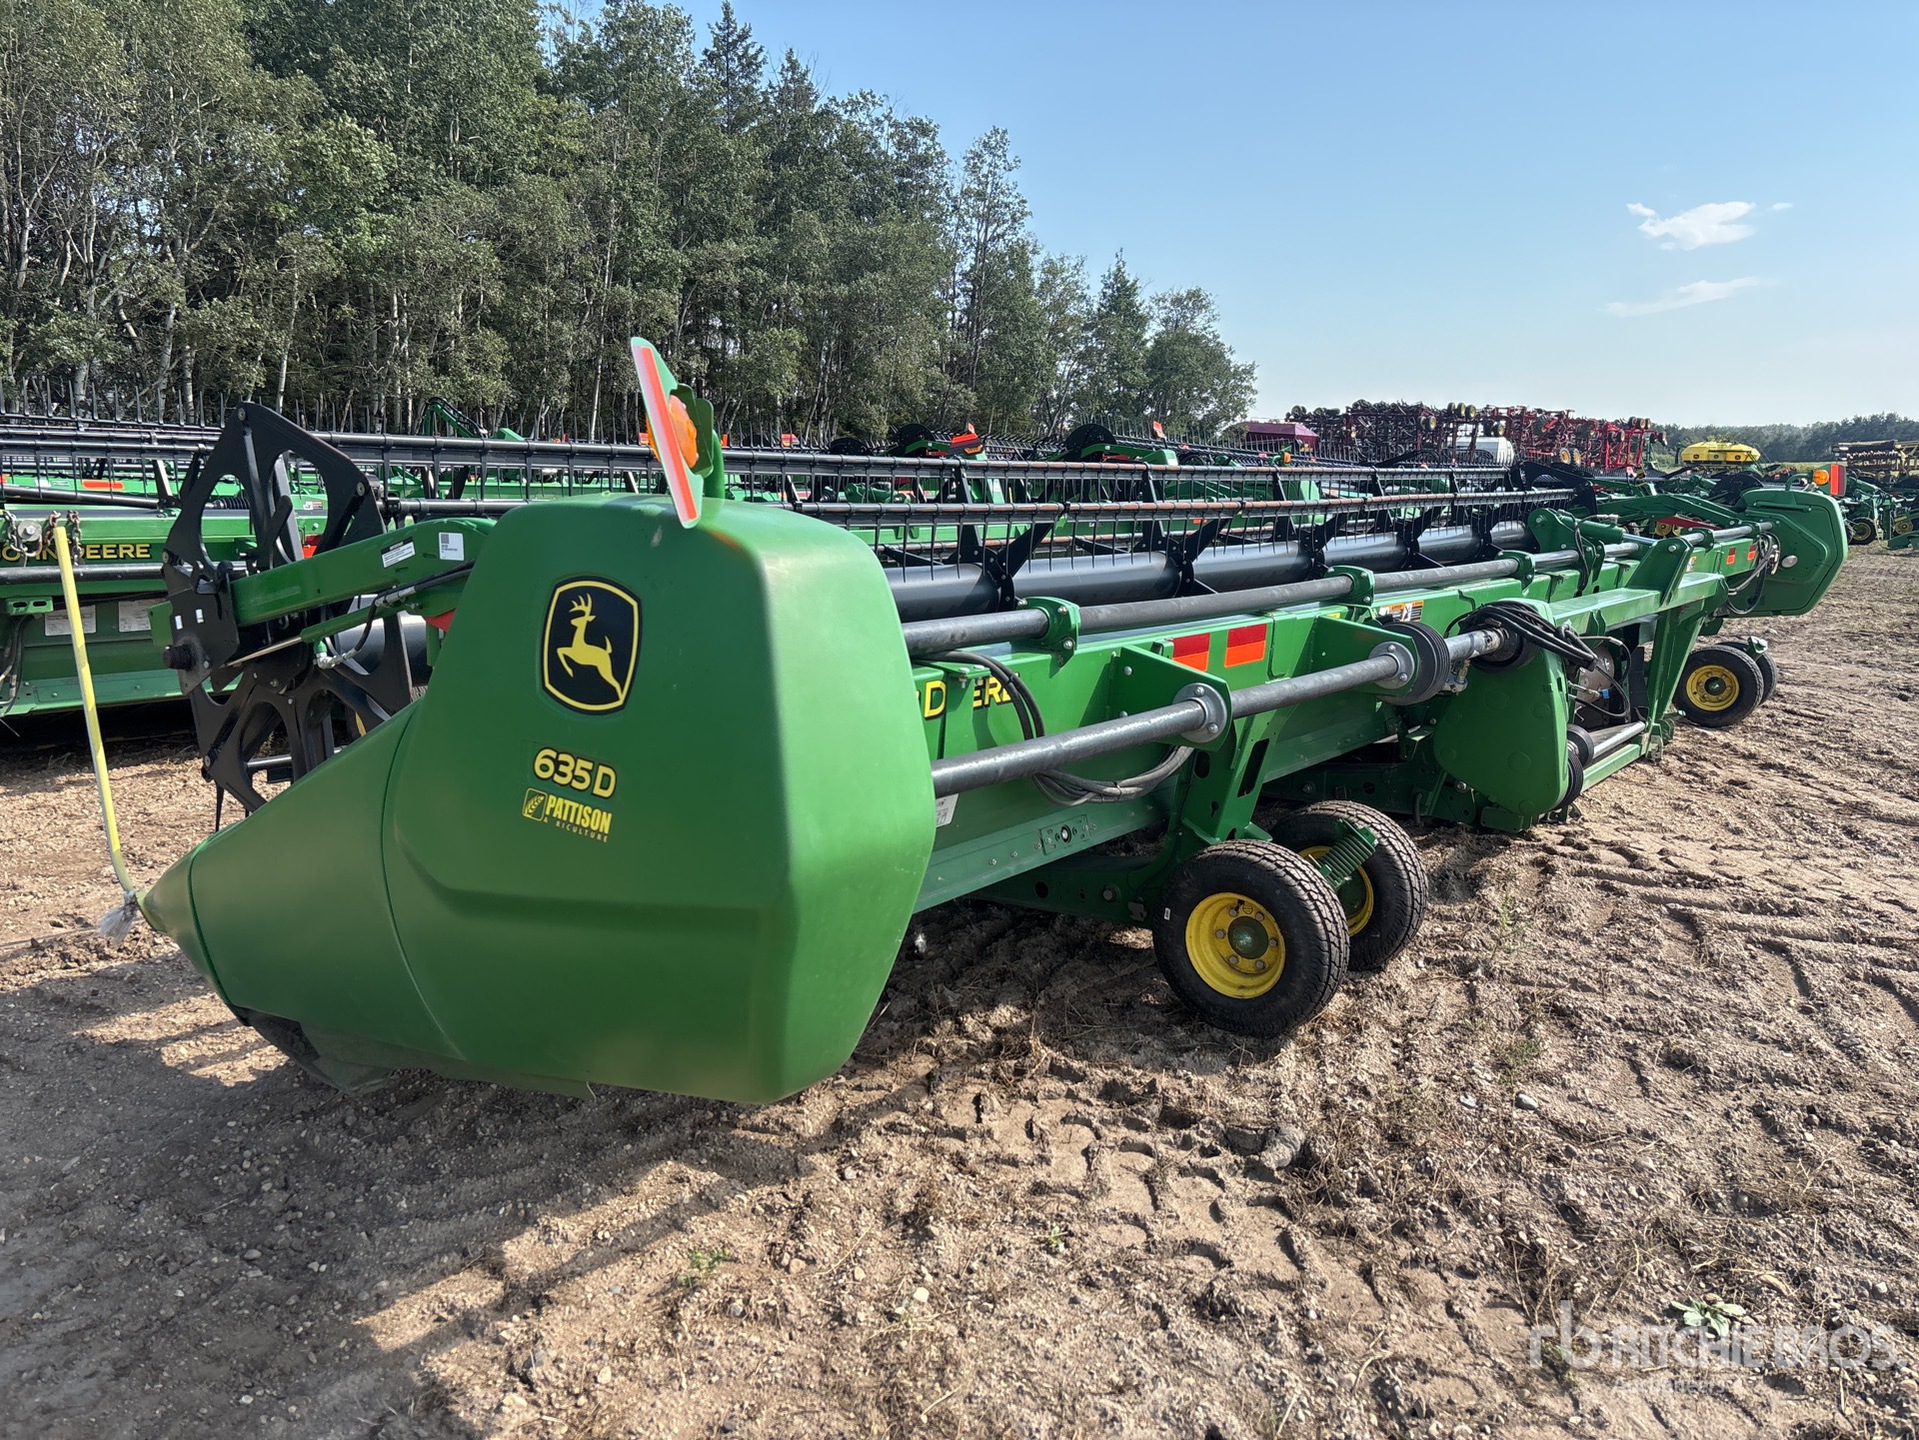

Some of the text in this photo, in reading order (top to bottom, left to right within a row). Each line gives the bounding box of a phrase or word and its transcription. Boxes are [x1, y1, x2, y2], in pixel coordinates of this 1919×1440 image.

[533, 747, 617, 799] 635D
[543, 816, 609, 844] ARICULTURE
[545, 794, 612, 835] PATTISON
